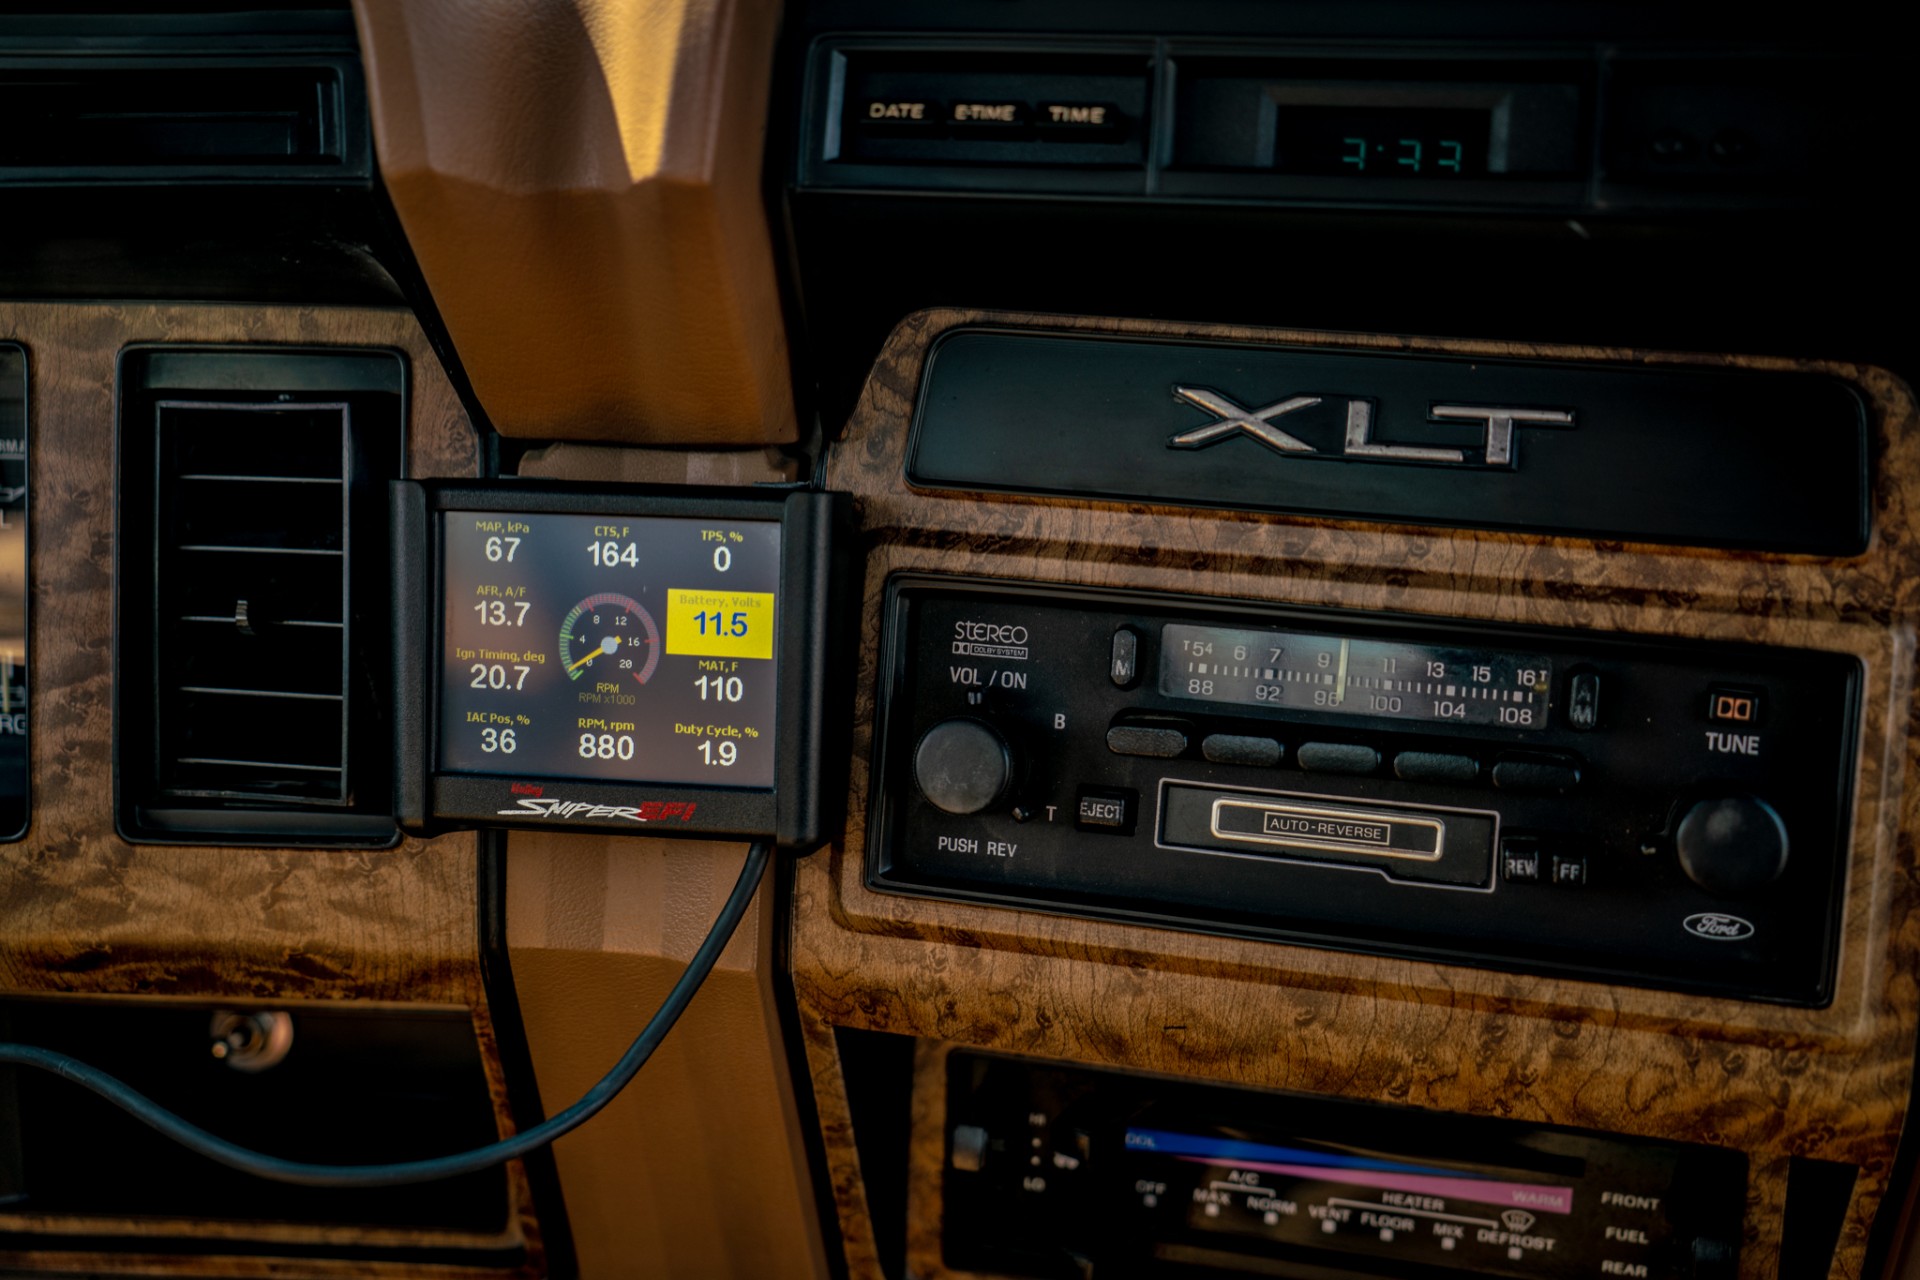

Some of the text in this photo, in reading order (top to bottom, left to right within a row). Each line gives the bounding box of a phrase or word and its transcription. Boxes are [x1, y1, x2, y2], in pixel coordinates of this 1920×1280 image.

[869, 103, 924, 119] DATE
[1049, 106, 1105, 123] TIME
[1173, 385, 1573, 465] XLT
[475, 521, 530, 533] MAP, kPa
[594, 526, 630, 538] CTS, F
[701, 530, 743, 543] TPS, %
[485, 536, 521, 562] 67
[587, 541, 639, 568] 164
[713, 546, 732, 572] 0
[476, 585, 526, 599] AFR, A/F
[679, 594, 761, 609] Battery, Volts
[474, 600, 531, 627] 13.7
[593, 615, 600, 625] 8
[615, 616, 627, 626] 12
[693, 611, 748, 637] 11.5
[579, 635, 586, 644] 4
[628, 637, 640, 647] 16
[456, 648, 545, 664] Ign Timing, deg
[974, 646, 1025, 657] DOLBY SYSTEM
[619, 659, 632, 669] 20
[699, 660, 739, 673] MAT, F
[1234, 645, 1247, 661] 6
[1269, 648, 1282, 663] 7
[1317, 653, 1330, 668] 9
[1383, 658, 1396, 674] 11
[1427, 661, 1445, 678] 13
[1472, 666, 1491, 682] 15
[470, 663, 531, 691] 20.7
[950, 666, 982, 685] VOL
[1001, 671, 1027, 689] ON
[596, 682, 619, 694] RPM
[694, 676, 743, 702] 110
[579, 692, 636, 705] RPM x1000
[1188, 679, 1532, 725] 88 92 96 100 104 108
[466, 712, 531, 726] IAC Pos, %
[578, 718, 635, 732] RPM, rpm
[1055, 714, 1066, 729] B
[675, 723, 759, 739] Duty Cycle, %
[481, 728, 517, 753] 36
[578, 733, 635, 760] 880
[1705, 732, 1760, 755] TUNE
[697, 740, 738, 767] 1.9
[637, 801, 697, 821] EFI
[1046, 806, 1057, 822] T
[1080, 802, 1122, 819] EJECT
[938, 836, 1017, 857] PUSH REV
[1506, 857, 1538, 878] REW
[1560, 863, 1580, 880] FF
[1697, 915, 1740, 936] Ford
[1228, 1170, 1259, 1186] A/C
[1135, 1180, 1166, 1195] OFF
[1193, 1188, 1231, 1205] MAX
[1382, 1191, 1445, 1212] HEATER
[1512, 1190, 1564, 1208] WARM
[1601, 1191, 1660, 1211] FRONT
[1247, 1196, 1298, 1215] NORM
[1308, 1205, 1350, 1222] VENT
[1360, 1212, 1415, 1232] FLOOR
[1433, 1223, 1465, 1240] MIX
[1477, 1229, 1556, 1251] DEFROST
[1604, 1226, 1649, 1244] FUEL
[1602, 1260, 1648, 1278] REAR
